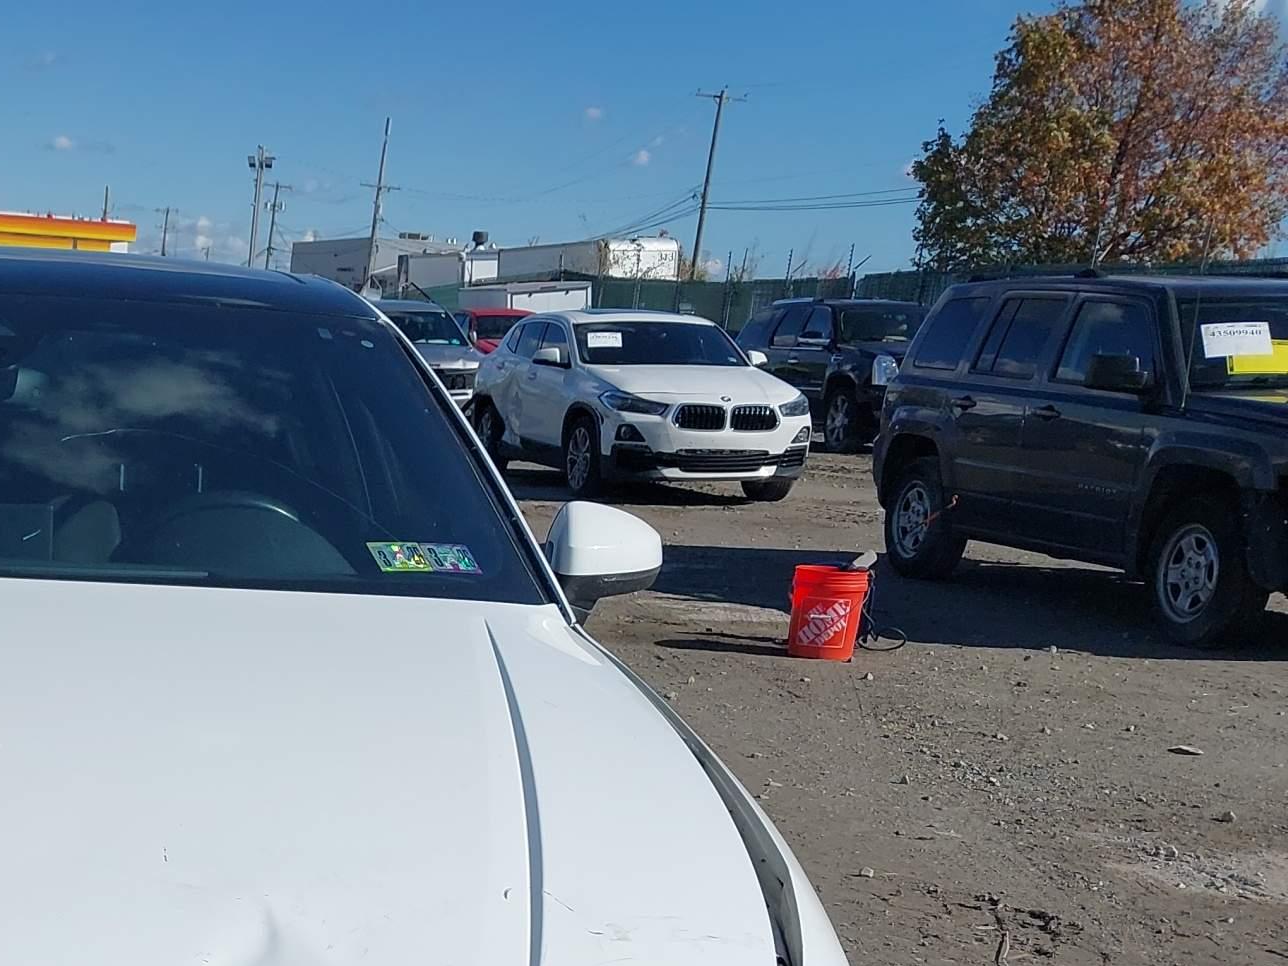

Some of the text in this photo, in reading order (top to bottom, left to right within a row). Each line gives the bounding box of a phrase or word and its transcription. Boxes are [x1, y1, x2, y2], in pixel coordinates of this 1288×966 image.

[427, 547, 444, 568] 3
[798, 599, 851, 644] HOME
[814, 618, 847, 647] DEPOT
